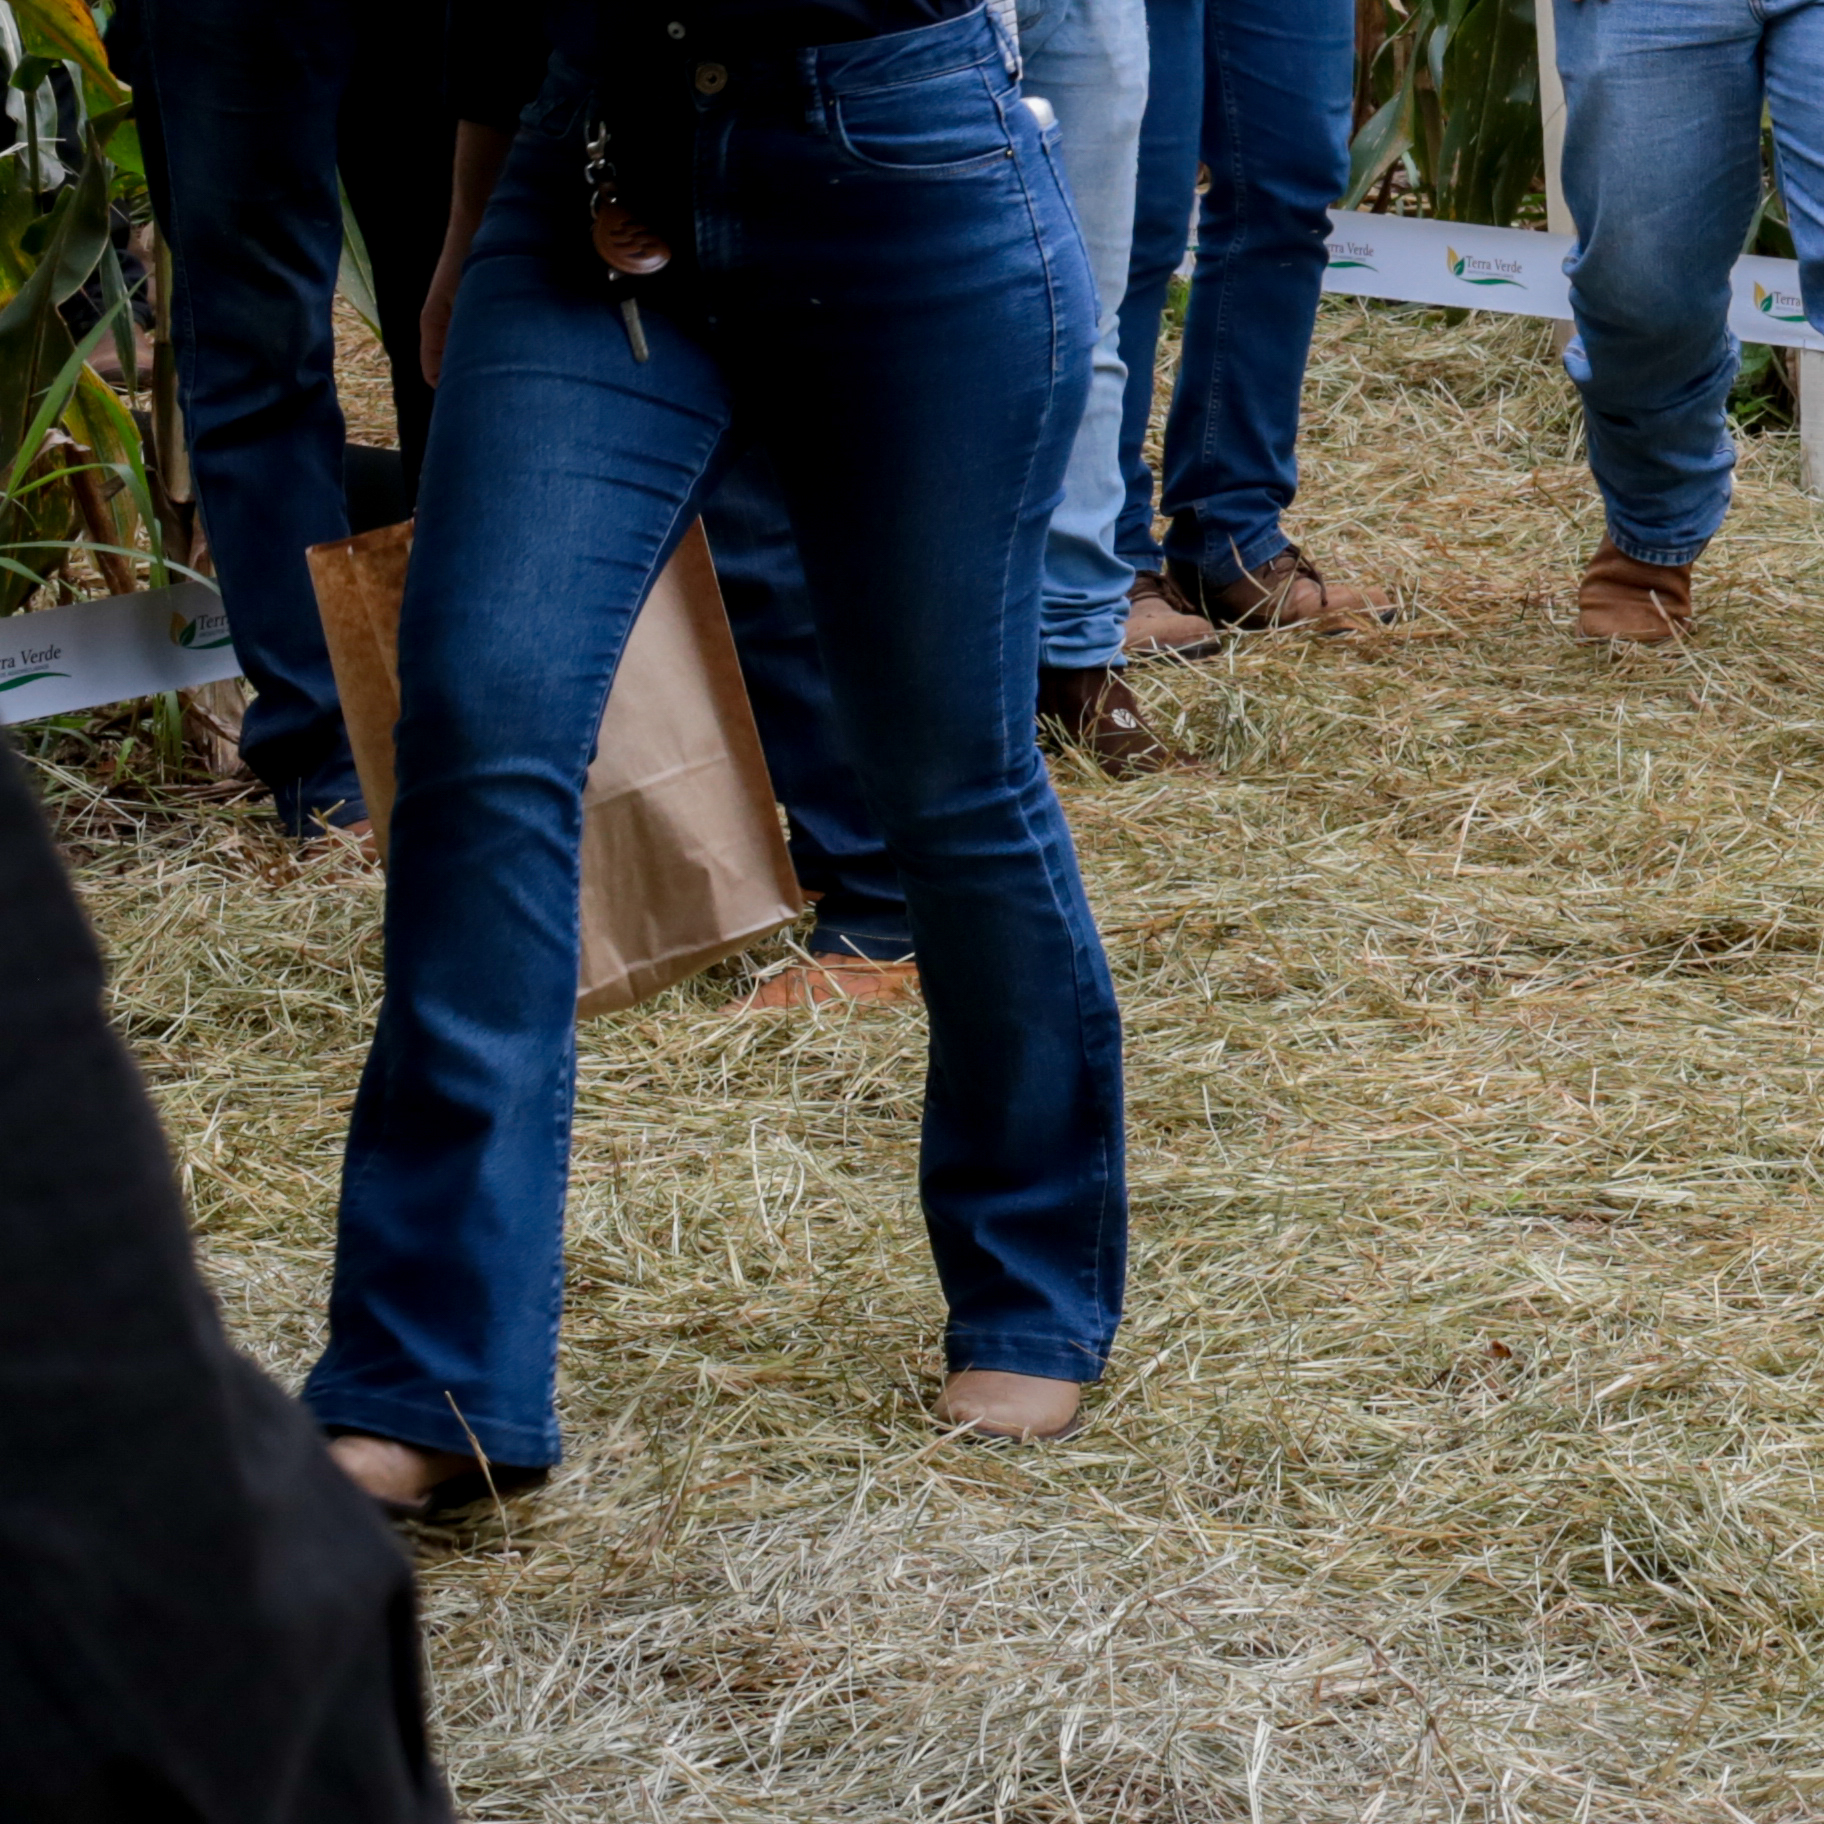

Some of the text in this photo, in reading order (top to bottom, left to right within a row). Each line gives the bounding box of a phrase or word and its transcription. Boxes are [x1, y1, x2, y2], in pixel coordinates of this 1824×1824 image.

[1347, 242, 1374, 257] Verde
[1466, 255, 1523, 274] Terra Verde
[1774, 291, 1800, 307] Terra
[198, 614, 228, 631] Terr
[21, 644, 61, 665] Verde
